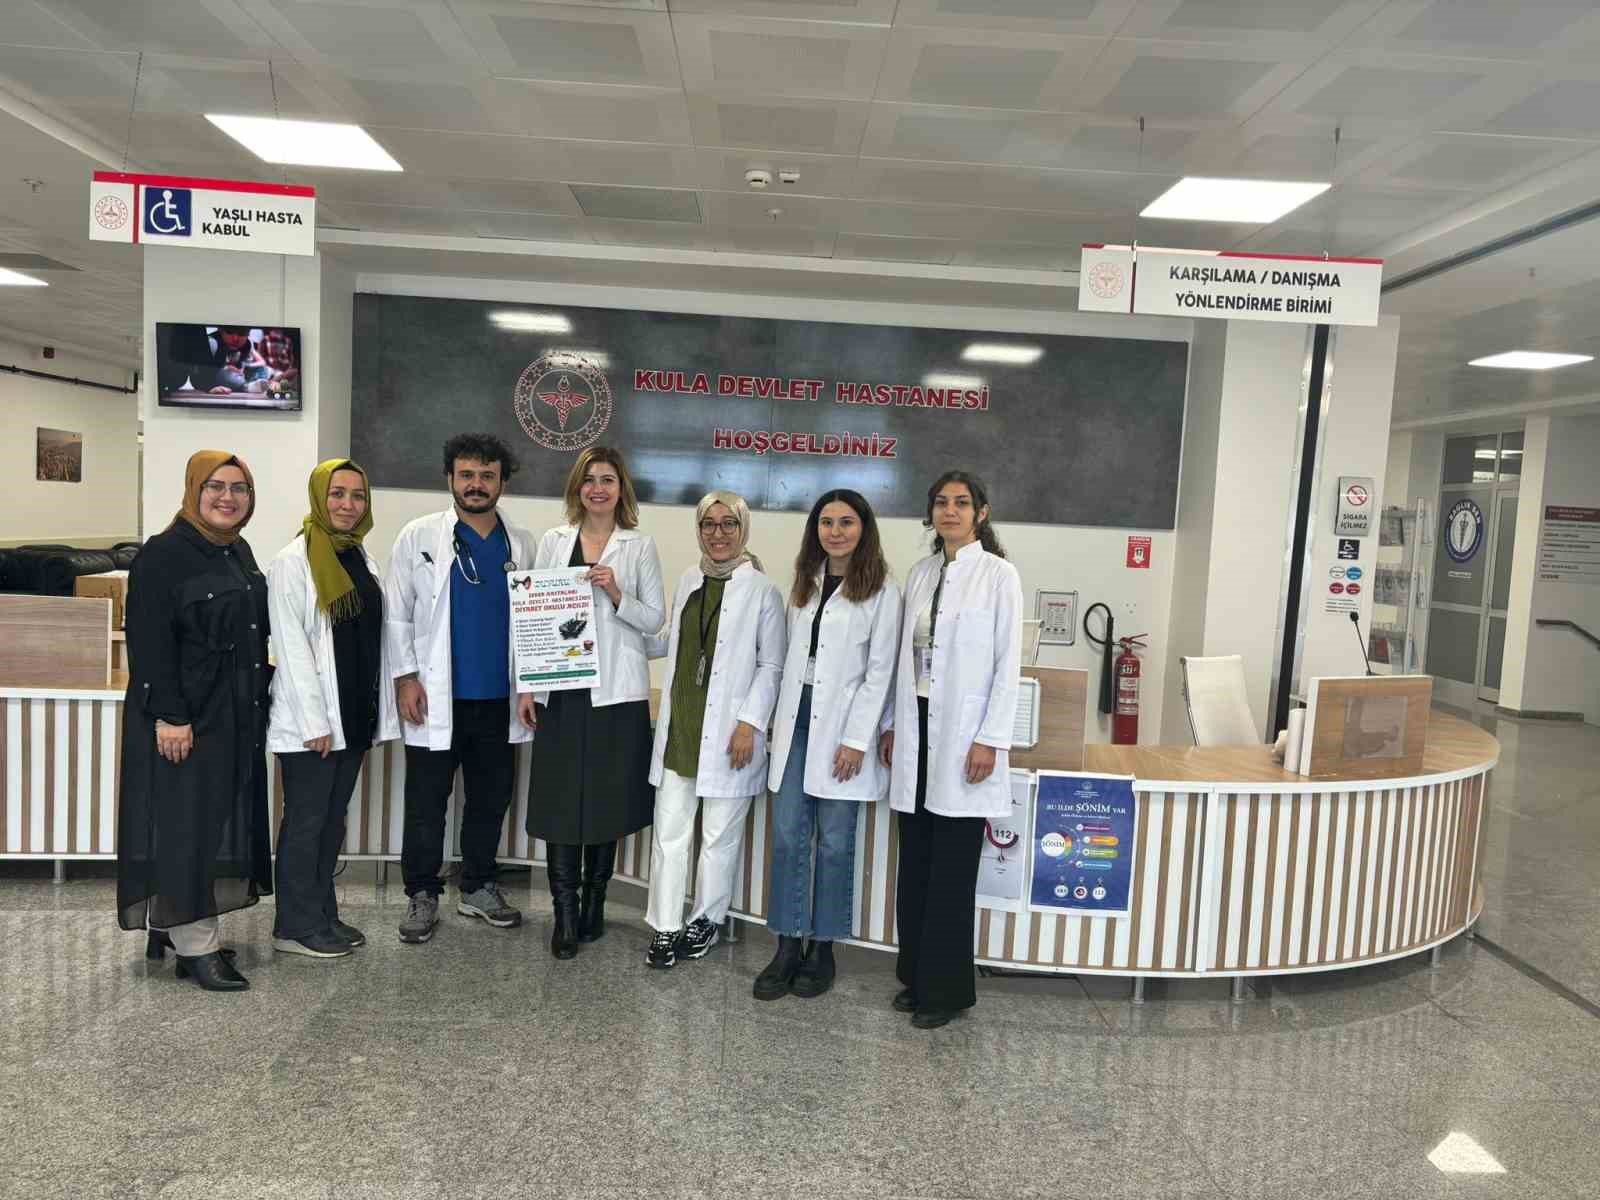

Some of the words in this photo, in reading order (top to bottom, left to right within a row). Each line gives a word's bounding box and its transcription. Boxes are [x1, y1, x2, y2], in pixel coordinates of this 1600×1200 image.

[213, 207, 252, 223] YAŞLI
[255, 211, 303, 225] HASTA
[202, 222, 250, 237] KABUL
[1169, 265, 1257, 284] KARŞILAMA
[1260, 270, 1269, 284] /
[1271, 271, 1341, 290] DANIŞMA
[1176, 291, 1282, 312] YÖNLENDİRME
[1285, 296, 1333, 314] BİRİMİ
[634, 369, 711, 394] KULA
[717, 375, 825, 401] DEVLET
[835, 382, 991, 411] HASTANESİ
[713, 428, 898, 459] HOŞGELDİNİZ
[1343, 512, 1368, 520] SİGARA
[1076, 801, 1111, 814] ŞÖNİM
[994, 829, 1012, 840] 112
